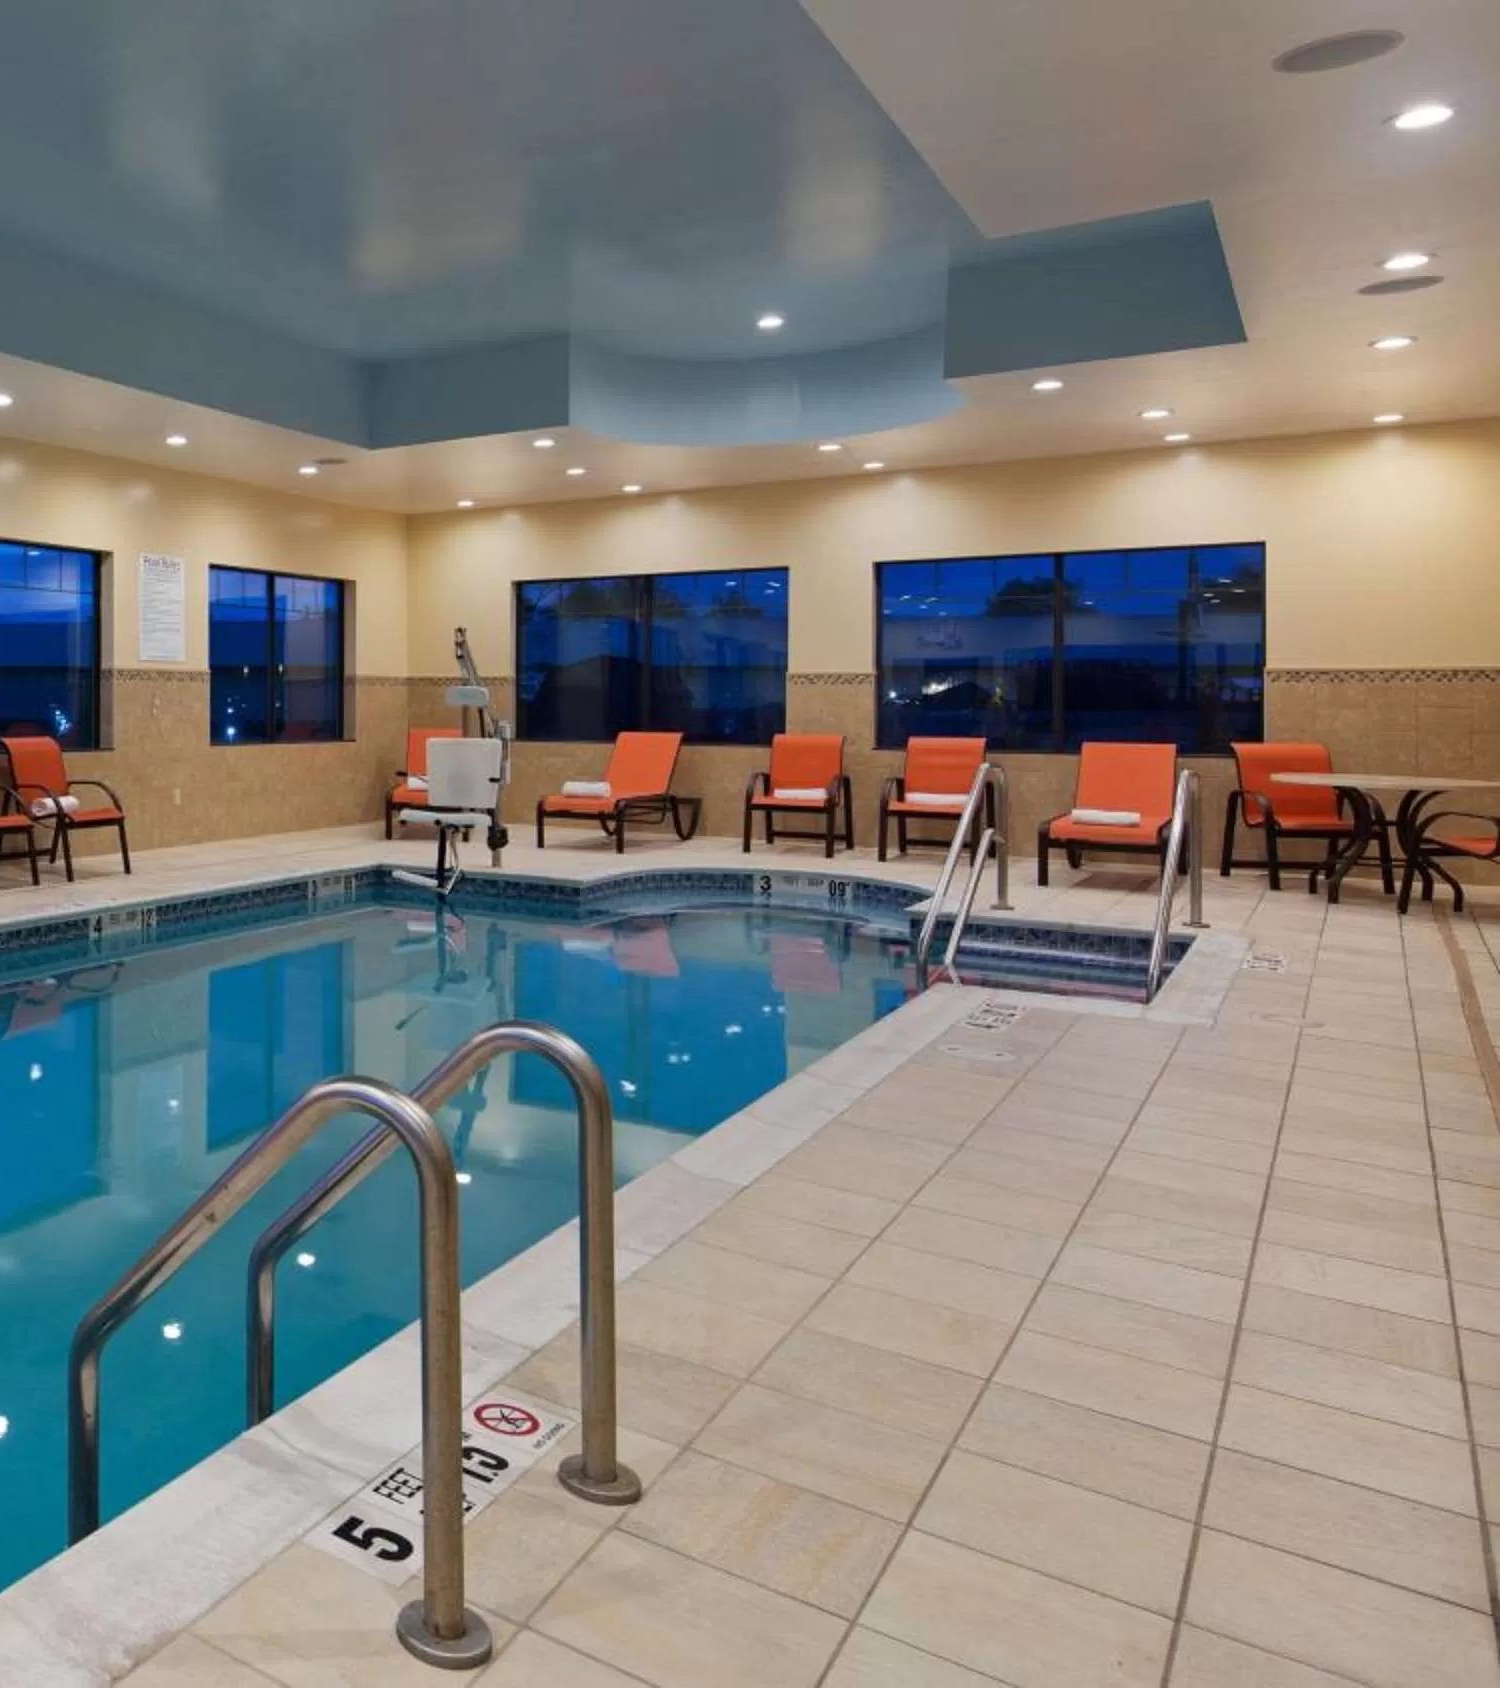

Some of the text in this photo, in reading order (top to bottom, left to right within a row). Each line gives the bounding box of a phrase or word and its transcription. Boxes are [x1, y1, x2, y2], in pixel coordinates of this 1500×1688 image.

[760, 876, 771, 891] 3
[372, 1467, 425, 1505] FEET
[331, 1515, 414, 1562] 5
